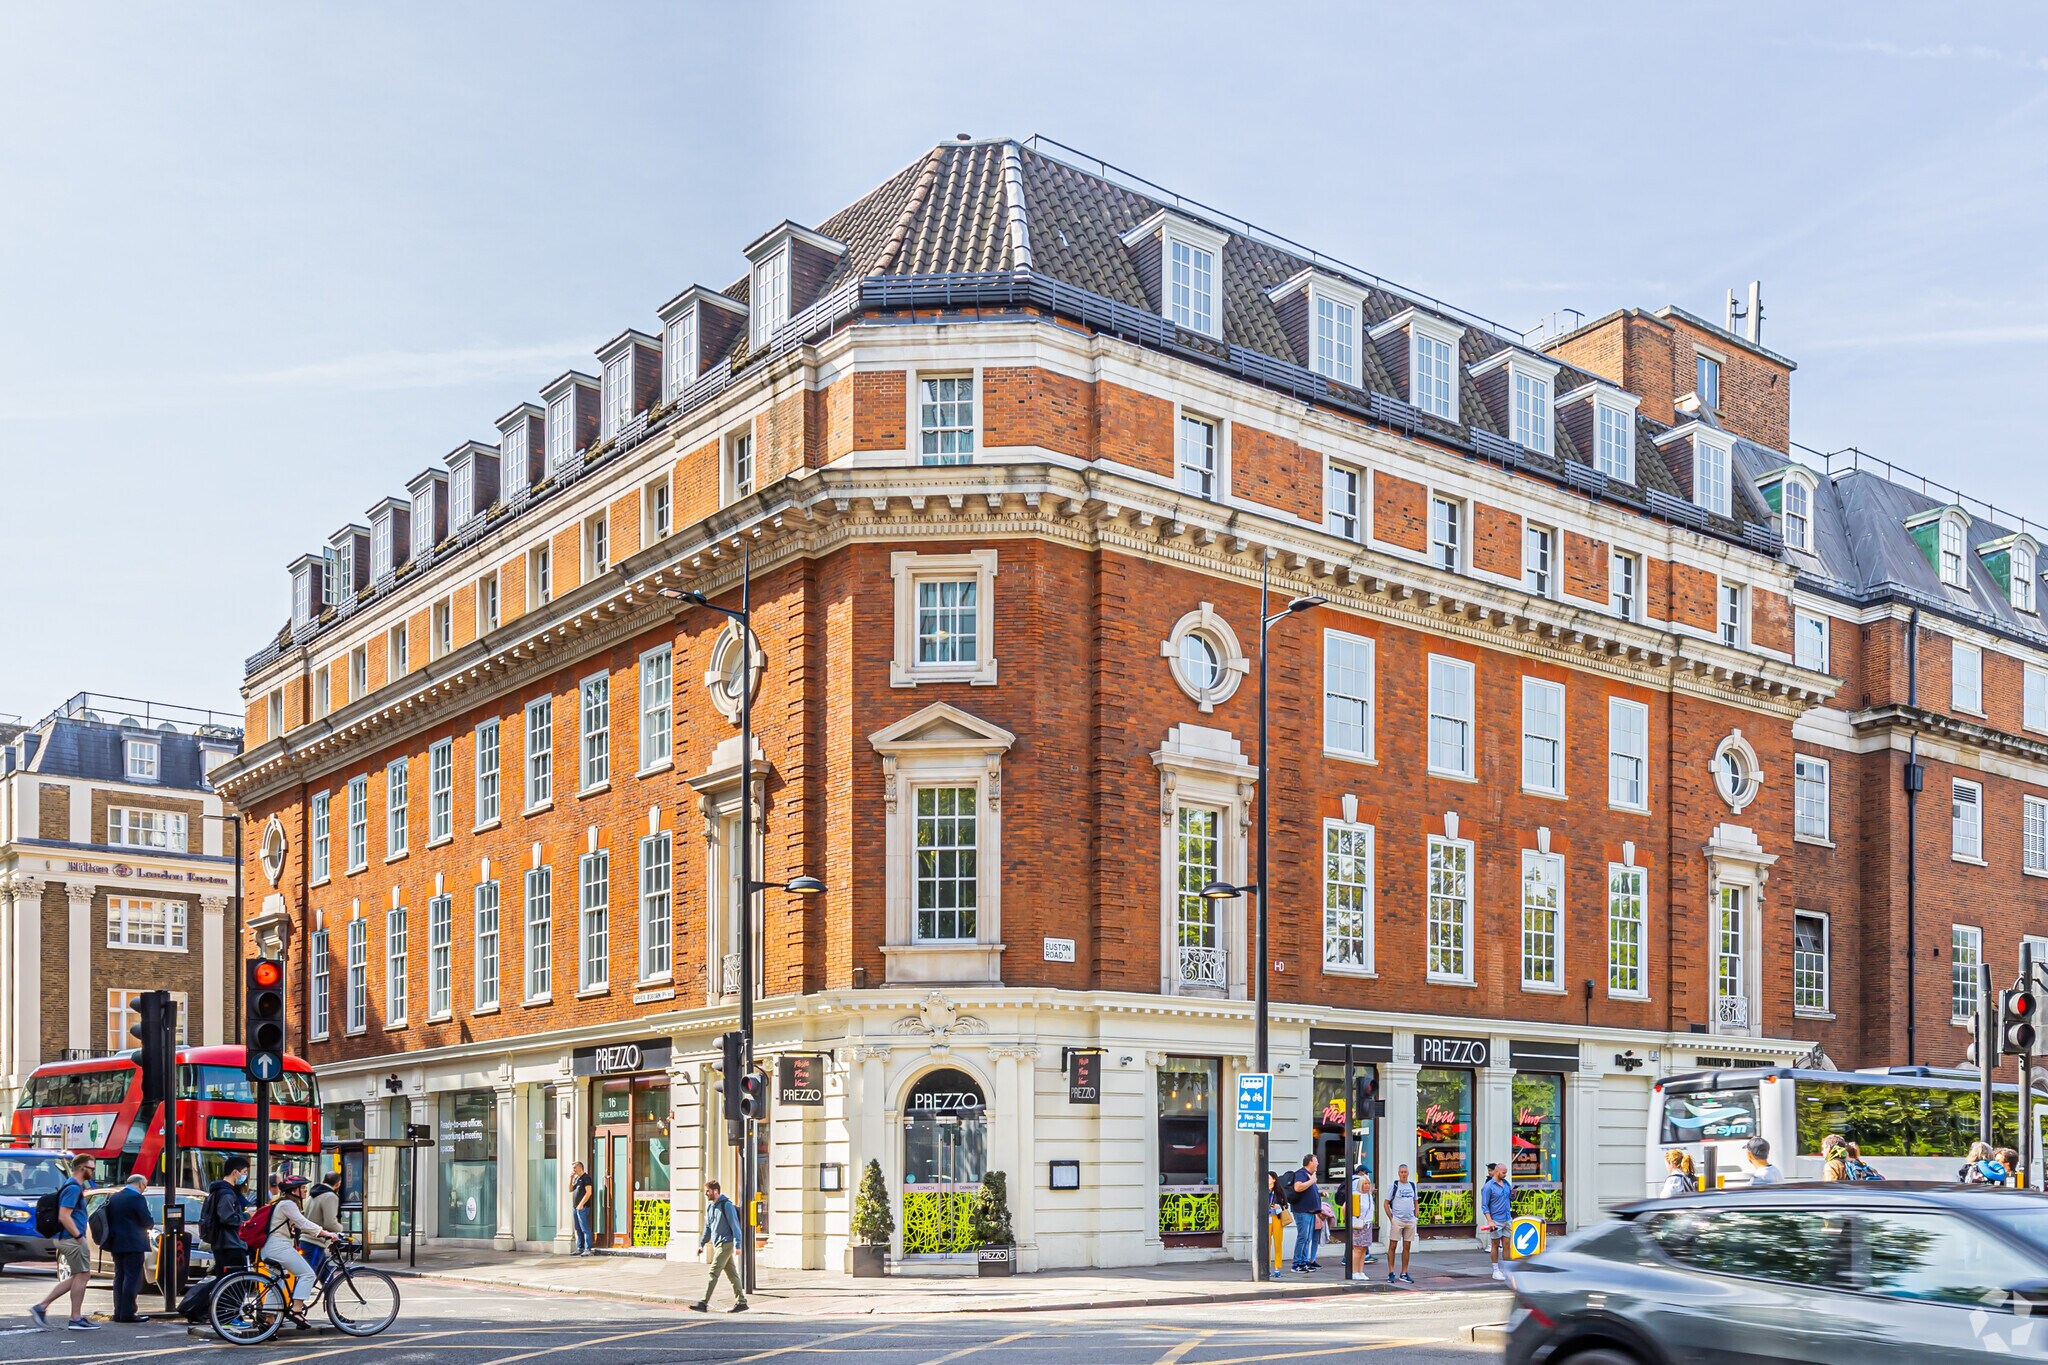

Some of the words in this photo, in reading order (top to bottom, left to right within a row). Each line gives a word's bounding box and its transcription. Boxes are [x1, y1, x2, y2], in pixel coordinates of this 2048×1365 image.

[68, 861, 109, 874] Hilton
[136, 868, 183, 881] London
[1045, 942, 1071, 951] EUSTON
[1045, 951, 1063, 959] ROAD
[1423, 1038, 1486, 1064] PREZZO
[595, 1044, 640, 1072] PREZZO
[783, 1089, 822, 1101] PREZZO
[1071, 1087, 1096, 1099] PREZZO
[608, 1097, 617, 1108] 16
[915, 1092, 978, 1110] PREZZO
[1425, 1103, 1456, 1125] Pizza
[1518, 1107, 1547, 1126] Vino
[71, 1123, 84, 1133] Food
[1703, 1124, 1747, 1136] airsym
[980, 1251, 1006, 1260] PREZZO
